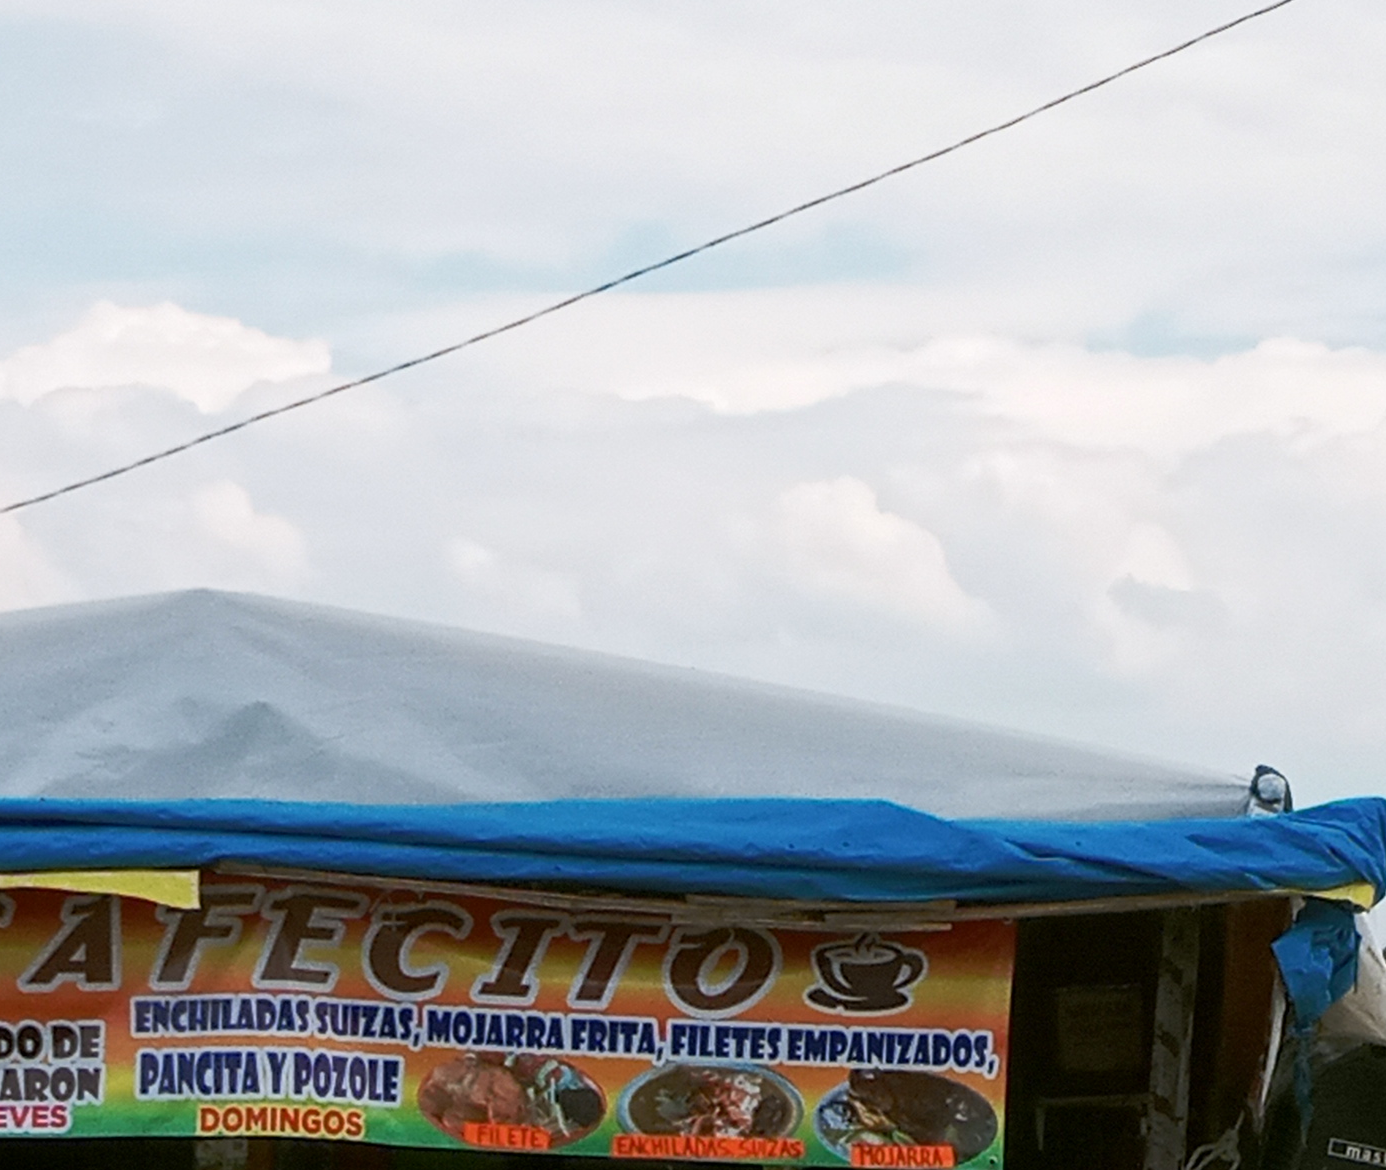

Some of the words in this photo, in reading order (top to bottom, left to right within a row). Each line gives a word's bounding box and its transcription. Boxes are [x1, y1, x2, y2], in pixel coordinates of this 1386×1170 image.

[50, 1024, 102, 1059] DE
[133, 997, 310, 1034] ENCHILADAS
[314, 1001, 420, 1047] SUIZAS,
[426, 1009, 564, 1050] MOJARRA
[570, 1018, 664, 1062] FRITA,
[670, 1022, 783, 1061] FILETES
[787, 1029, 996, 1074] EMPANIZADOS,
[139, 1051, 261, 1096] PANCITA
[266, 1051, 288, 1095] Y
[293, 1053, 401, 1103] POZOLE
[199, 1106, 364, 1136] DOMINGOS
[476, 1124, 542, 1149] FILETE
[616, 1136, 729, 1159] ENCHILADAS
[738, 1139, 802, 1158] SUIZAS
[862, 1144, 944, 1168] MOJARRA
